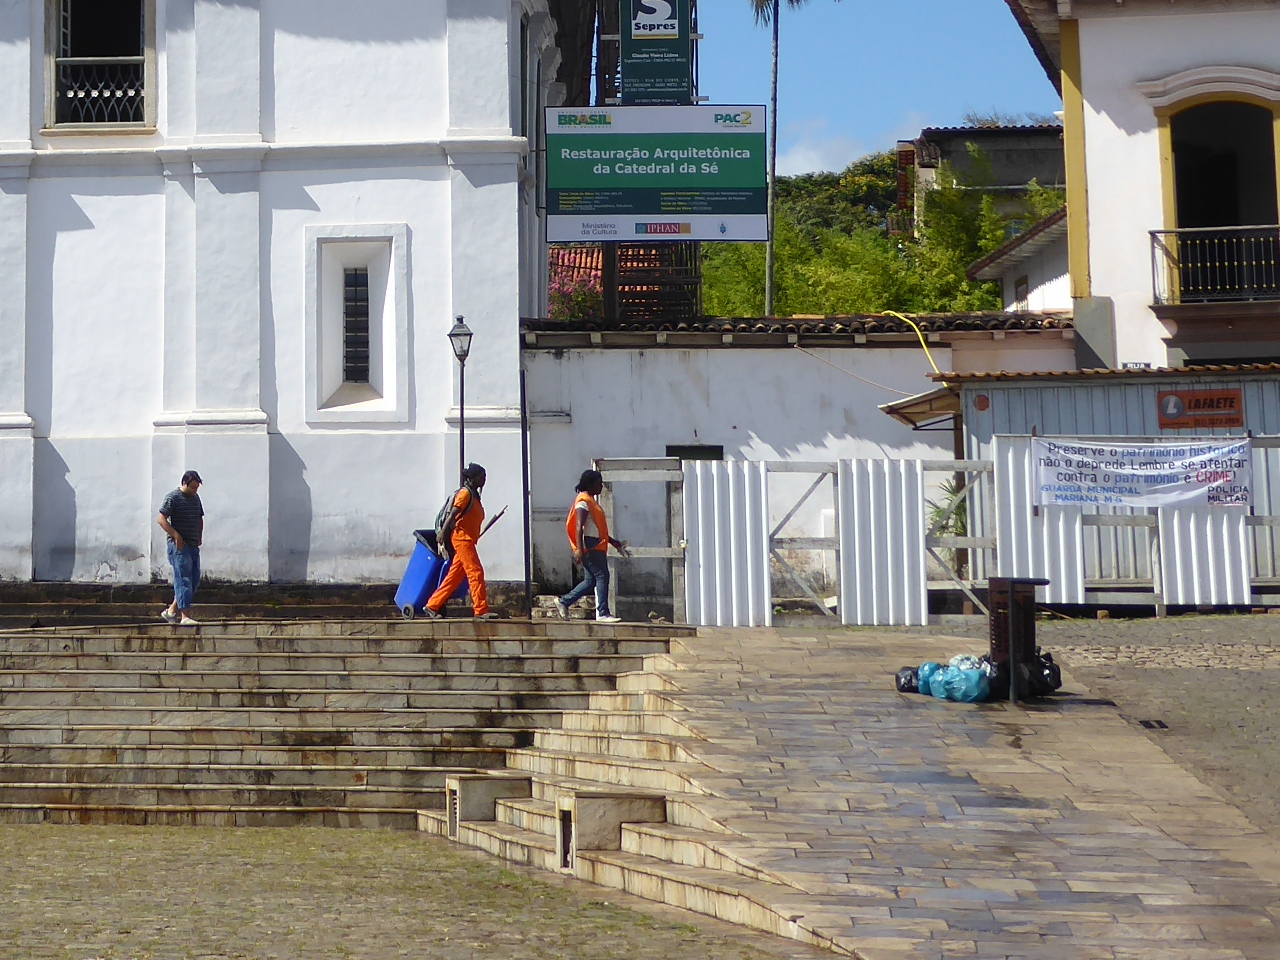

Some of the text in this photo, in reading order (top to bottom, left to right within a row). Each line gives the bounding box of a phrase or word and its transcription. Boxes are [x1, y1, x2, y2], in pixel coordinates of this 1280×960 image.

[634, 22, 676, 32] Sepres
[558, 114, 612, 126] BRASIL
[714, 111, 752, 125] PAC2
[561, 147, 750, 161] Restauração Arquitetônica
[593, 162, 718, 174] da Catedral da Sé
[647, 223, 680, 233] IPHAN
[1187, 396, 1236, 410] LAFAETE
[1048, 442, 1105, 456] Preserve
[1109, 448, 1118, 457] o
[1038, 456, 1060, 468] não
[1065, 459, 1072, 468] o
[1076, 458, 1126, 471] deprede
[1130, 459, 1175, 471] Lembre
[1200, 456, 1248, 469] atentar
[1056, 471, 1098, 483] contra
[1103, 473, 1110, 483] o
[1184, 474, 1191, 484] e
[1196, 470, 1236, 483] CRIME!
[1041, 484, 1141, 495] GUARDA MUNICIPAL
[1055, 493, 1100, 503] MARIANA
[1207, 494, 1248, 503] MILITAR
